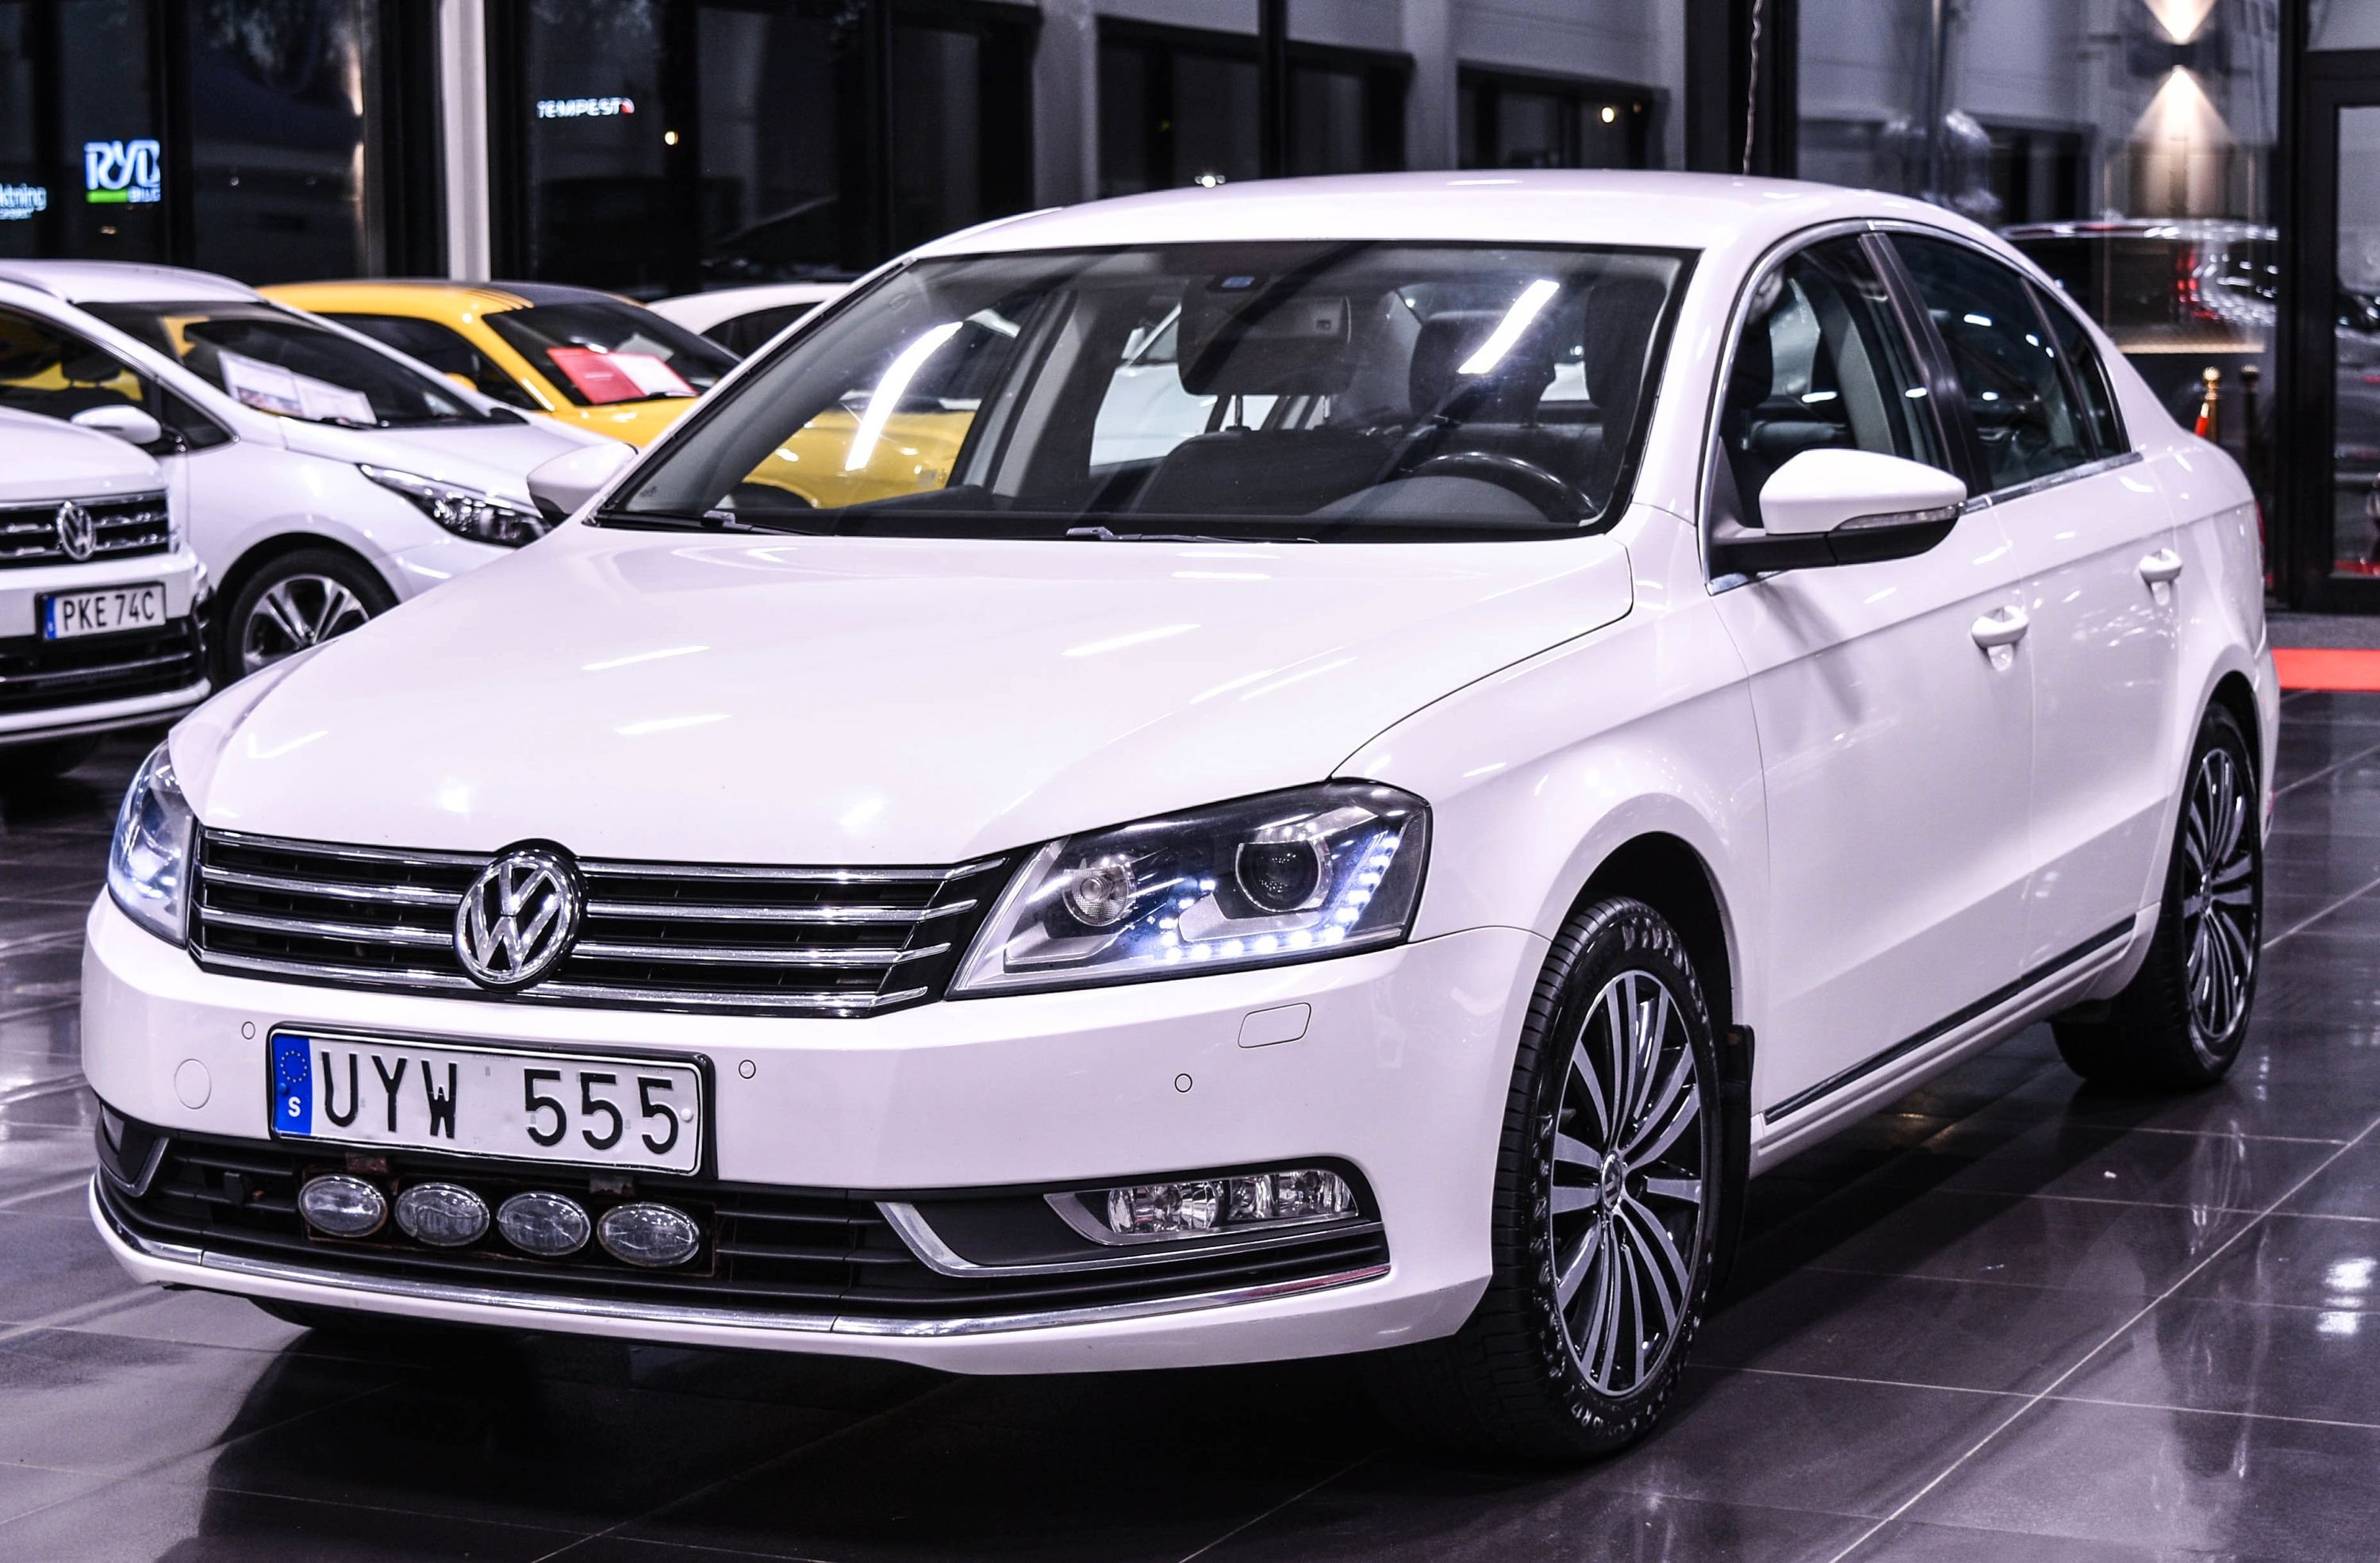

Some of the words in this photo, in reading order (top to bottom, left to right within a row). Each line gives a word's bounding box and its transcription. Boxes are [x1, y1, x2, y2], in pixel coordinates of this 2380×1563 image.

[537, 97, 622, 118] TEMPEST
[63, 597, 108, 632] PKE
[115, 590, 155, 625] 74C
[457, 853, 574, 985] VW
[288, 1096, 301, 1118] S
[321, 1051, 458, 1139] UYW
[524, 1067, 679, 1155] 555
